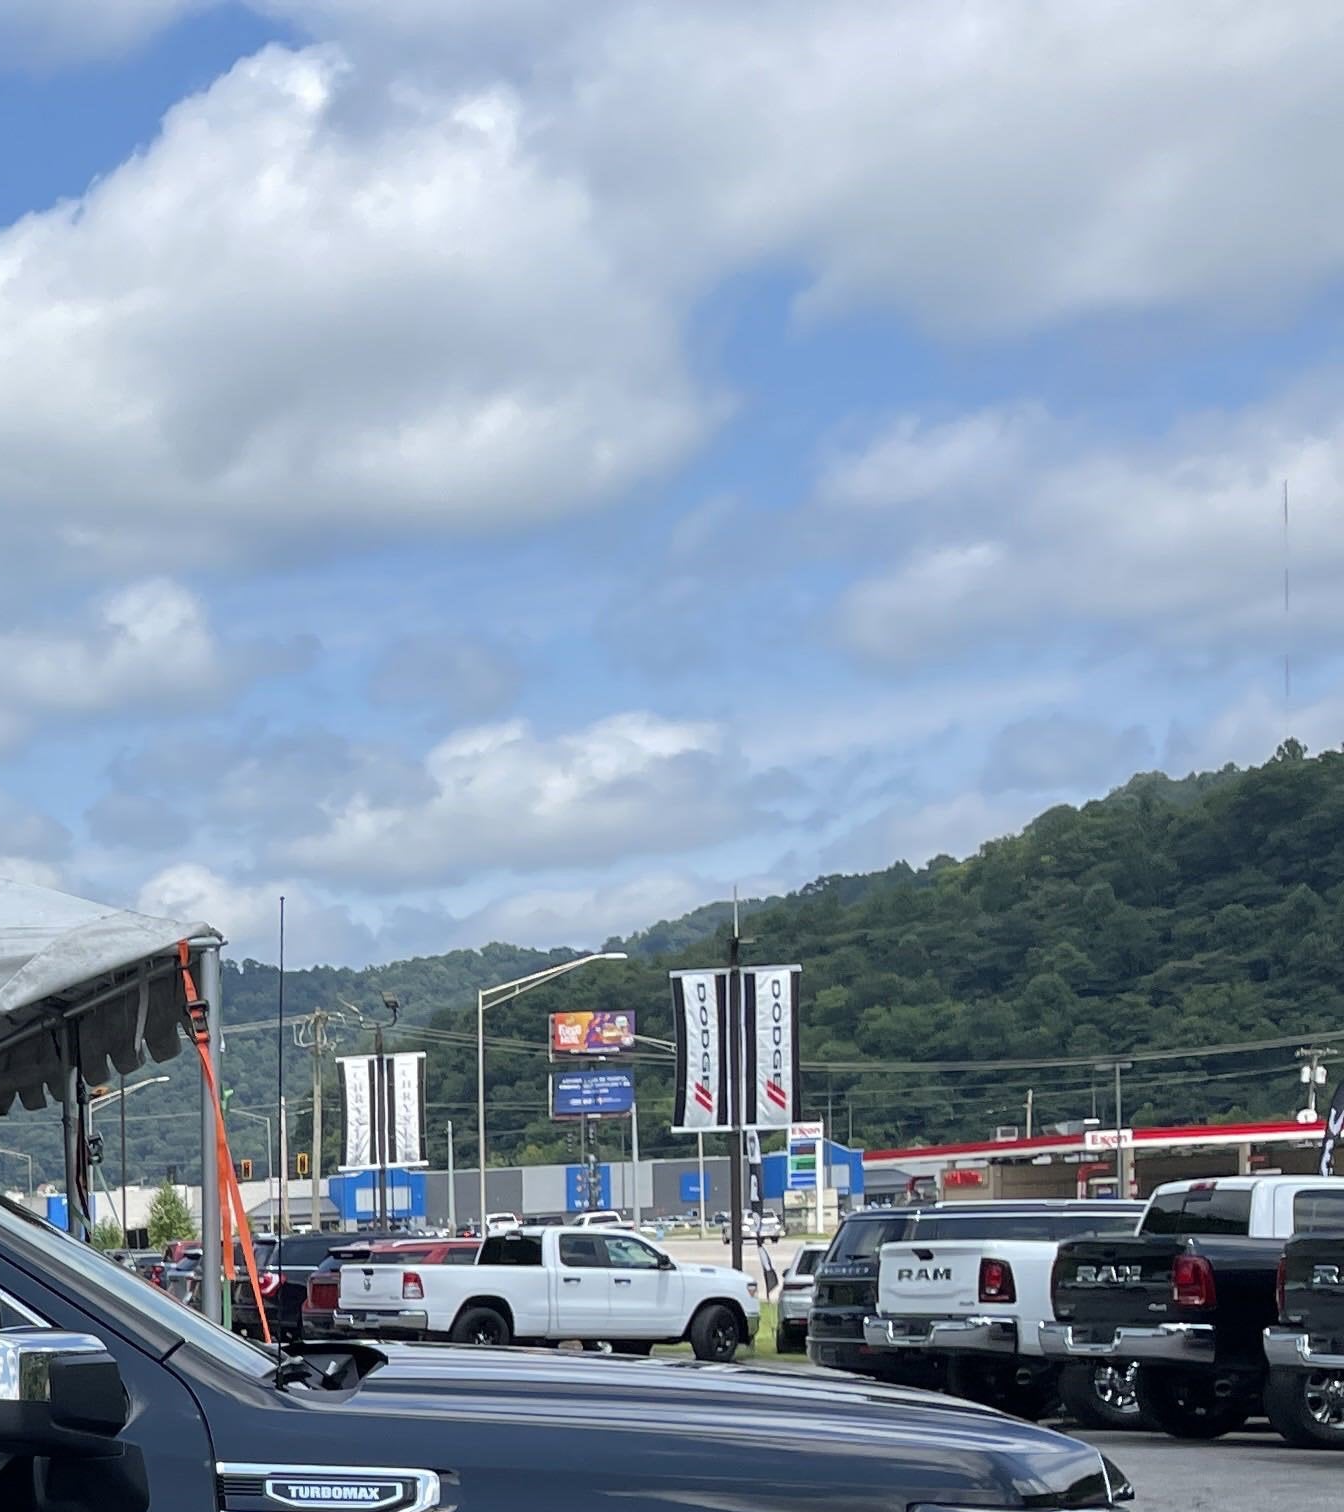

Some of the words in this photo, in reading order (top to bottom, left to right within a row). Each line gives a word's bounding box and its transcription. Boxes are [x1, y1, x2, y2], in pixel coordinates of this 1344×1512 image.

[696, 982, 711, 1092] DODGE
[772, 979, 782, 1090] DODGE
[897, 1267, 953, 1282] RAM
[1075, 1264, 1143, 1282] RAM
[287, 1484, 381, 1501] TURBOMAX
